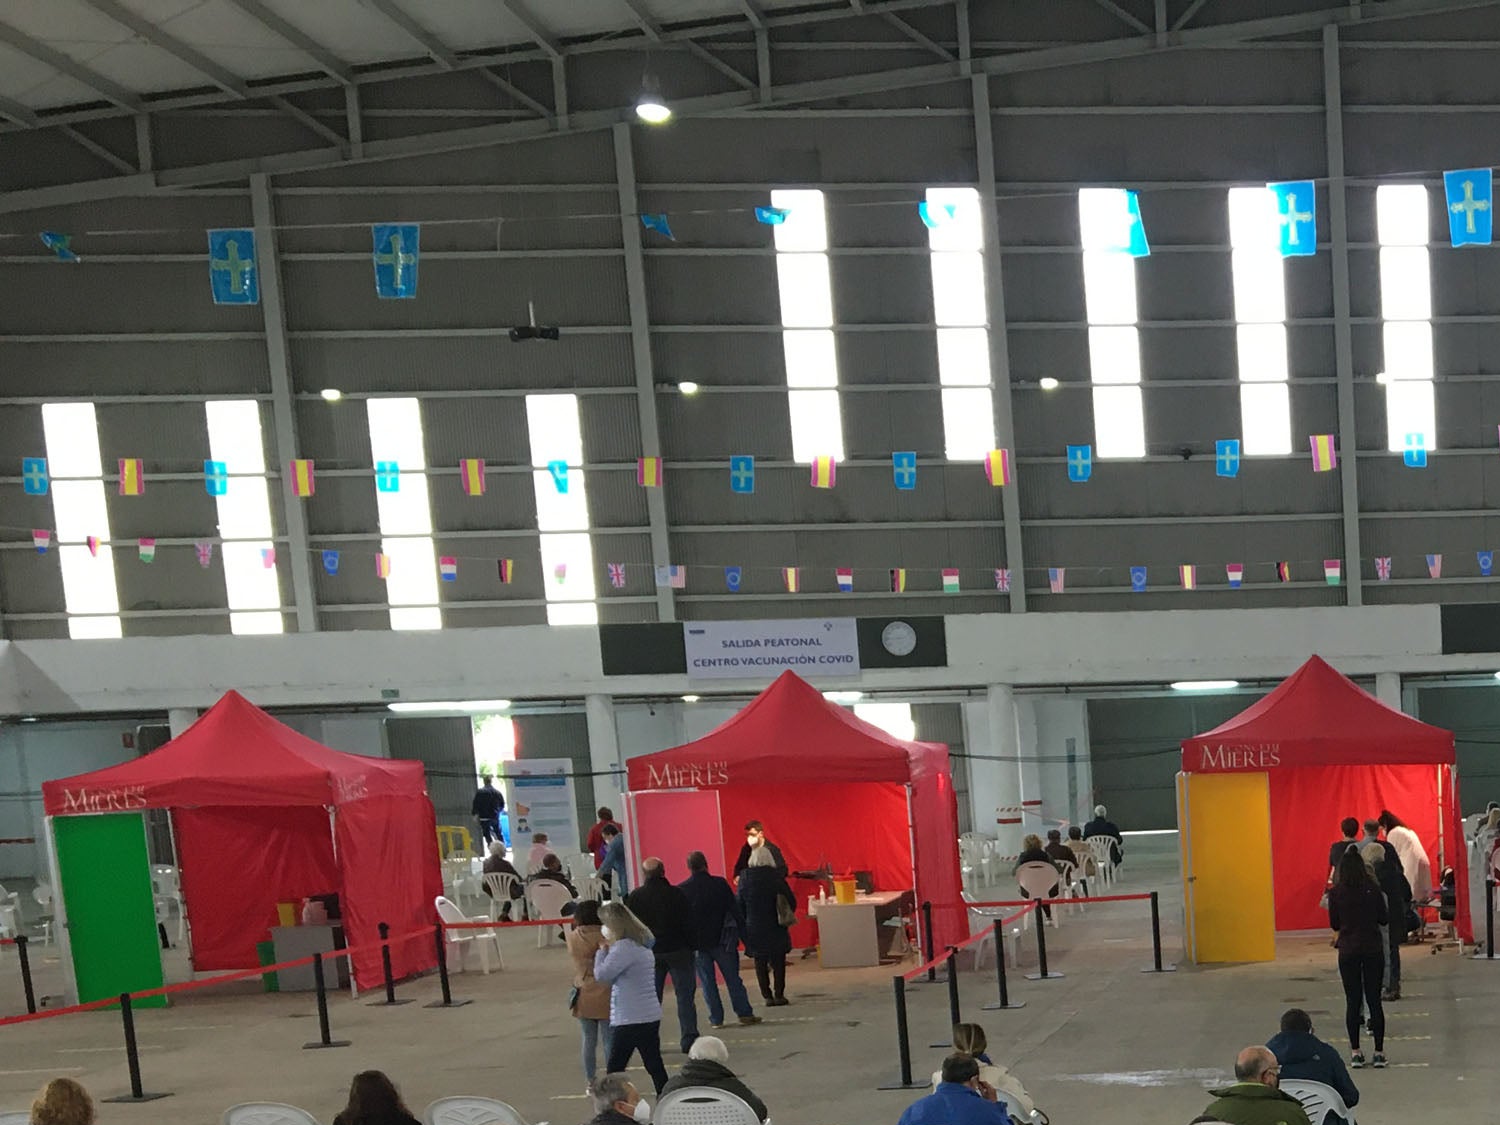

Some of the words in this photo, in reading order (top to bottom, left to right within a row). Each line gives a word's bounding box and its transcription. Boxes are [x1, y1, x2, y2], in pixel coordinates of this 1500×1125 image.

[721, 639, 761, 649] SALIDA
[764, 637, 823, 647] PEATONAL
[693, 657, 739, 667] CENTRO
[740, 653, 816, 666] VACUNACIÓN
[819, 654, 854, 664] COVID
[1201, 744, 1281, 769] MIERES
[646, 763, 729, 788] MIERES
